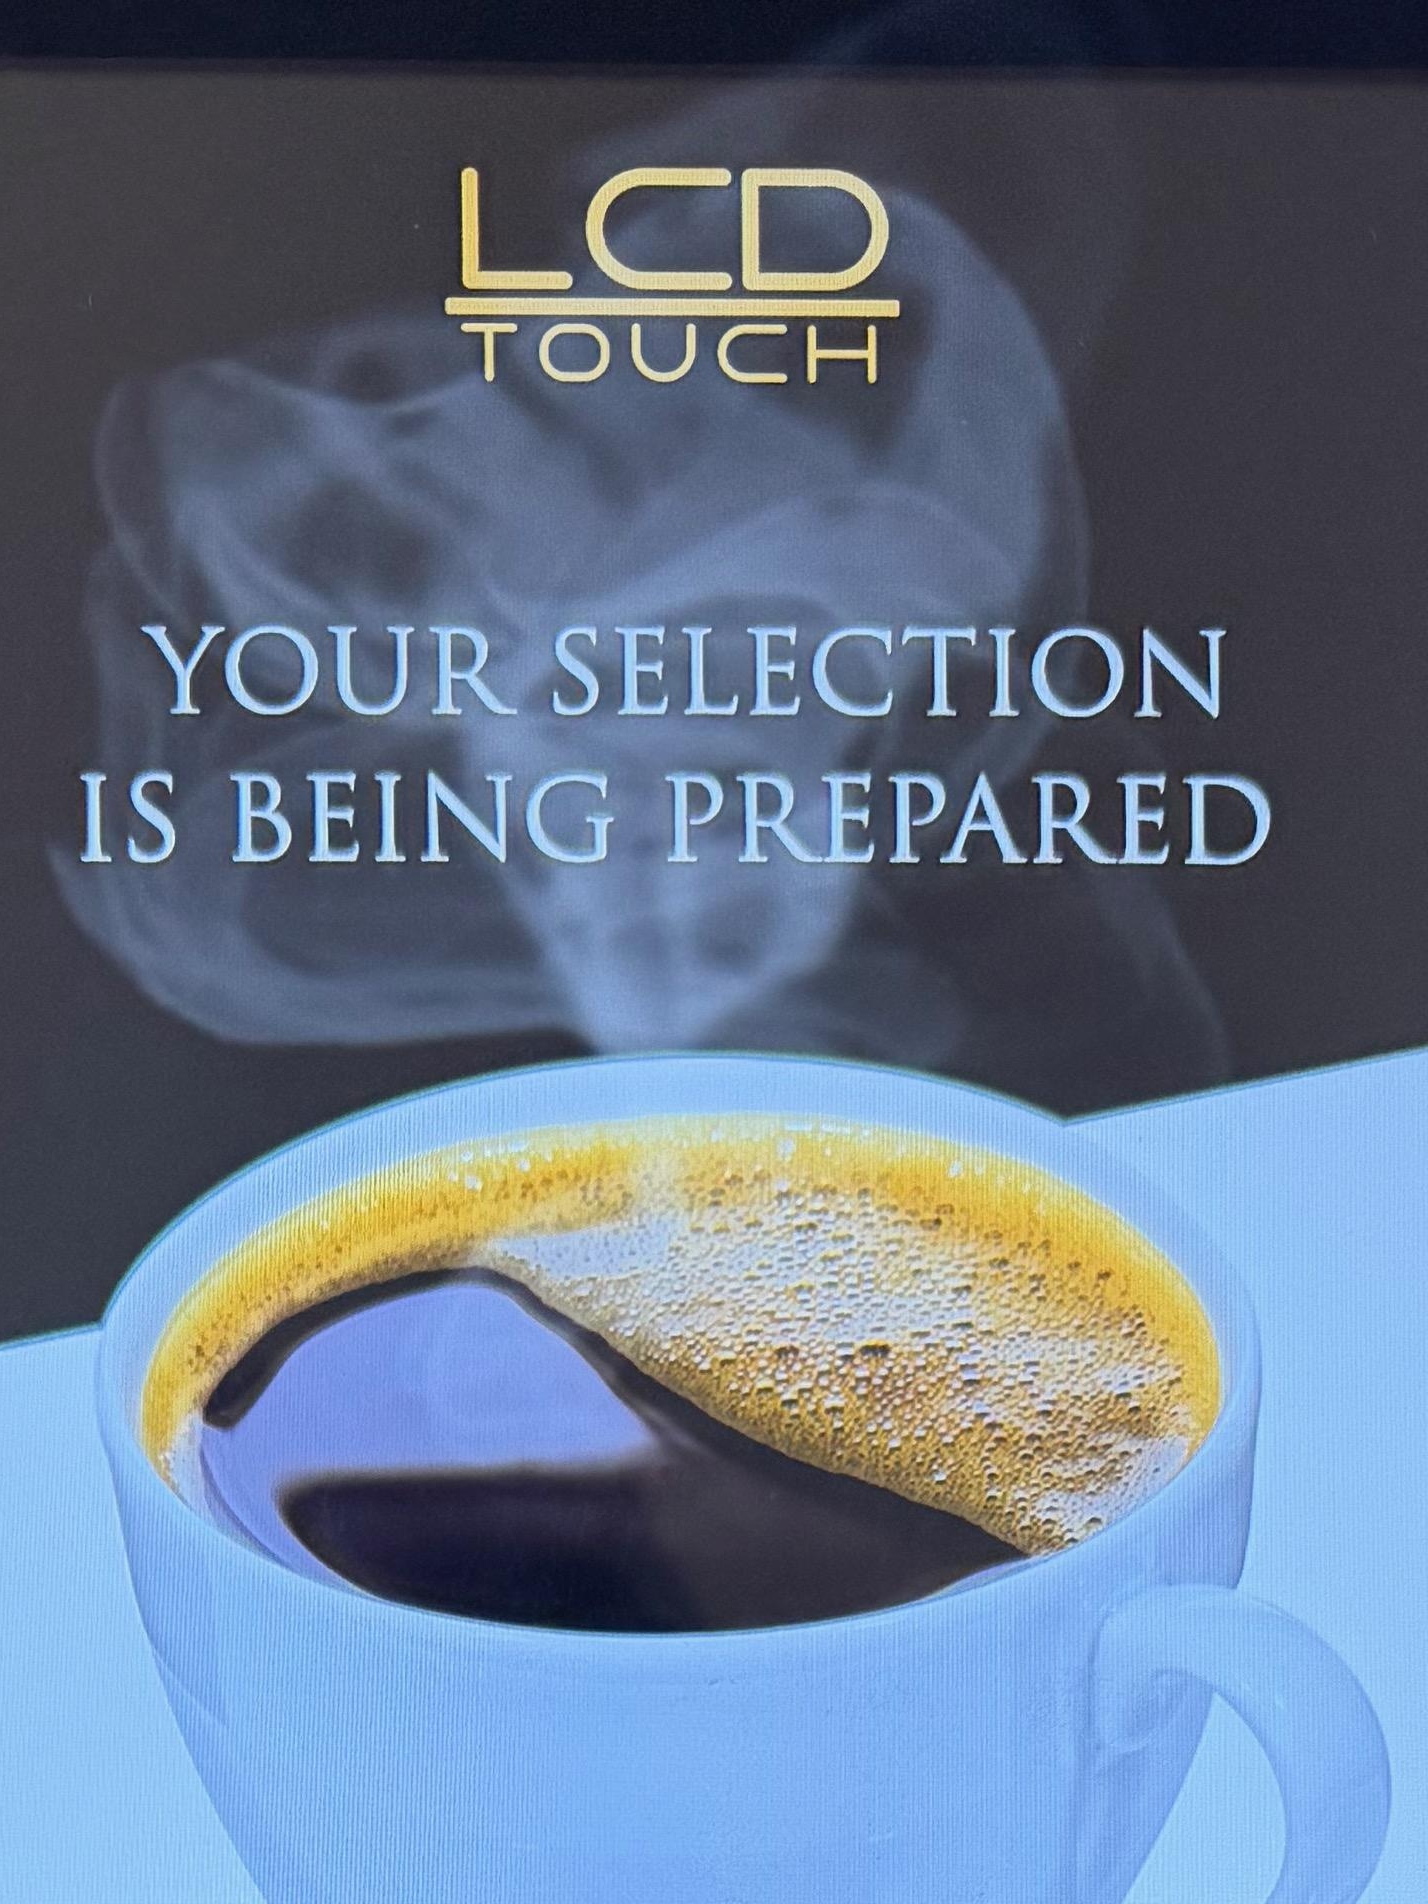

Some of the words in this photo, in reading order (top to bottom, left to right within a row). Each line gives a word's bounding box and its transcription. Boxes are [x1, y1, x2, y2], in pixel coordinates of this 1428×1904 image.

[460, 166, 890, 292] LCD
[460, 321, 878, 385] TOUCH
[141, 622, 518, 718] YOUR
[551, 622, 1227, 719] SELECTION
[79, 770, 177, 864] IS
[230, 768, 615, 866] BEING
[664, 770, 1272, 868] PREPARED
